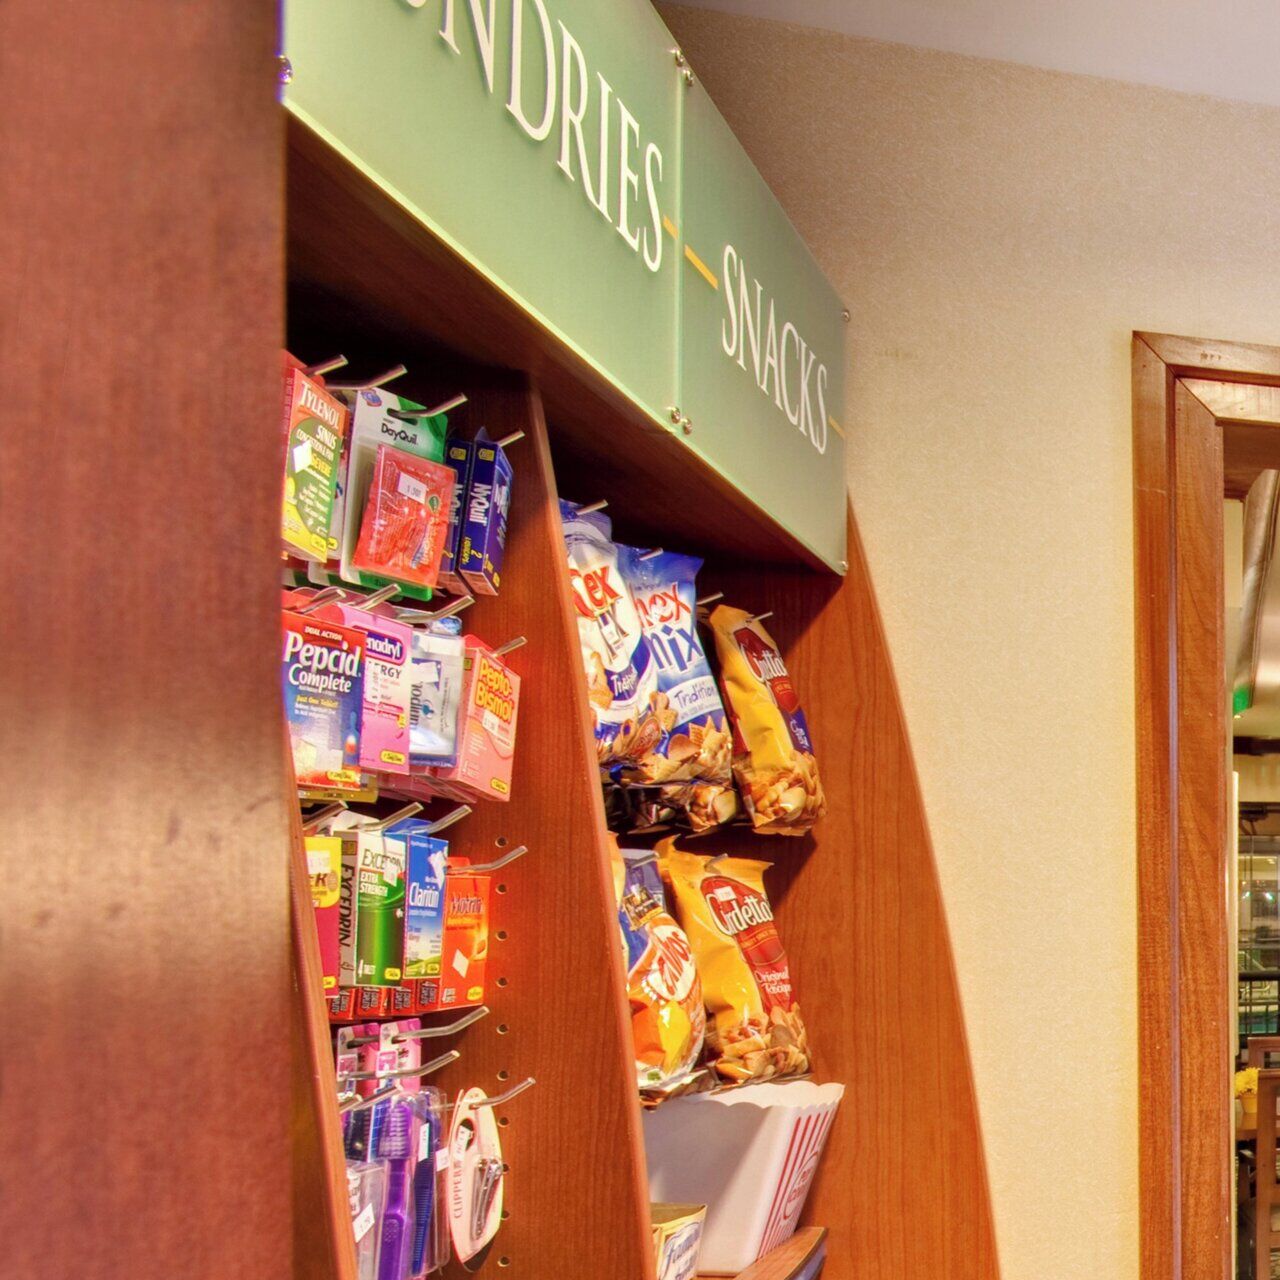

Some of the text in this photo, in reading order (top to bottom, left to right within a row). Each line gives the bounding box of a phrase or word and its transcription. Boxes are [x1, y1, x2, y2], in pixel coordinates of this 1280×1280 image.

[721, 244, 829, 455] SNACKS
[301, 380, 341, 431] TYLENOL
[316, 424, 338, 451] SINUS
[380, 424, 418, 446] DayQuil
[469, 482, 493, 527] NyQuil
[630, 582, 692, 629] hex
[304, 625, 343, 641] DUAL ACTION
[366, 633, 401, 661] nadryl
[283, 631, 360, 678] Pepcid
[288, 663, 352, 693] Complete
[480, 656, 512, 697] Pepto-
[475, 680, 515, 725] Bismol
[360, 871, 380, 884] EXTRA
[339, 863, 355, 947] EXCEDRIN
[409, 882, 440, 909] Claritin
[755, 963, 790, 983] Original
